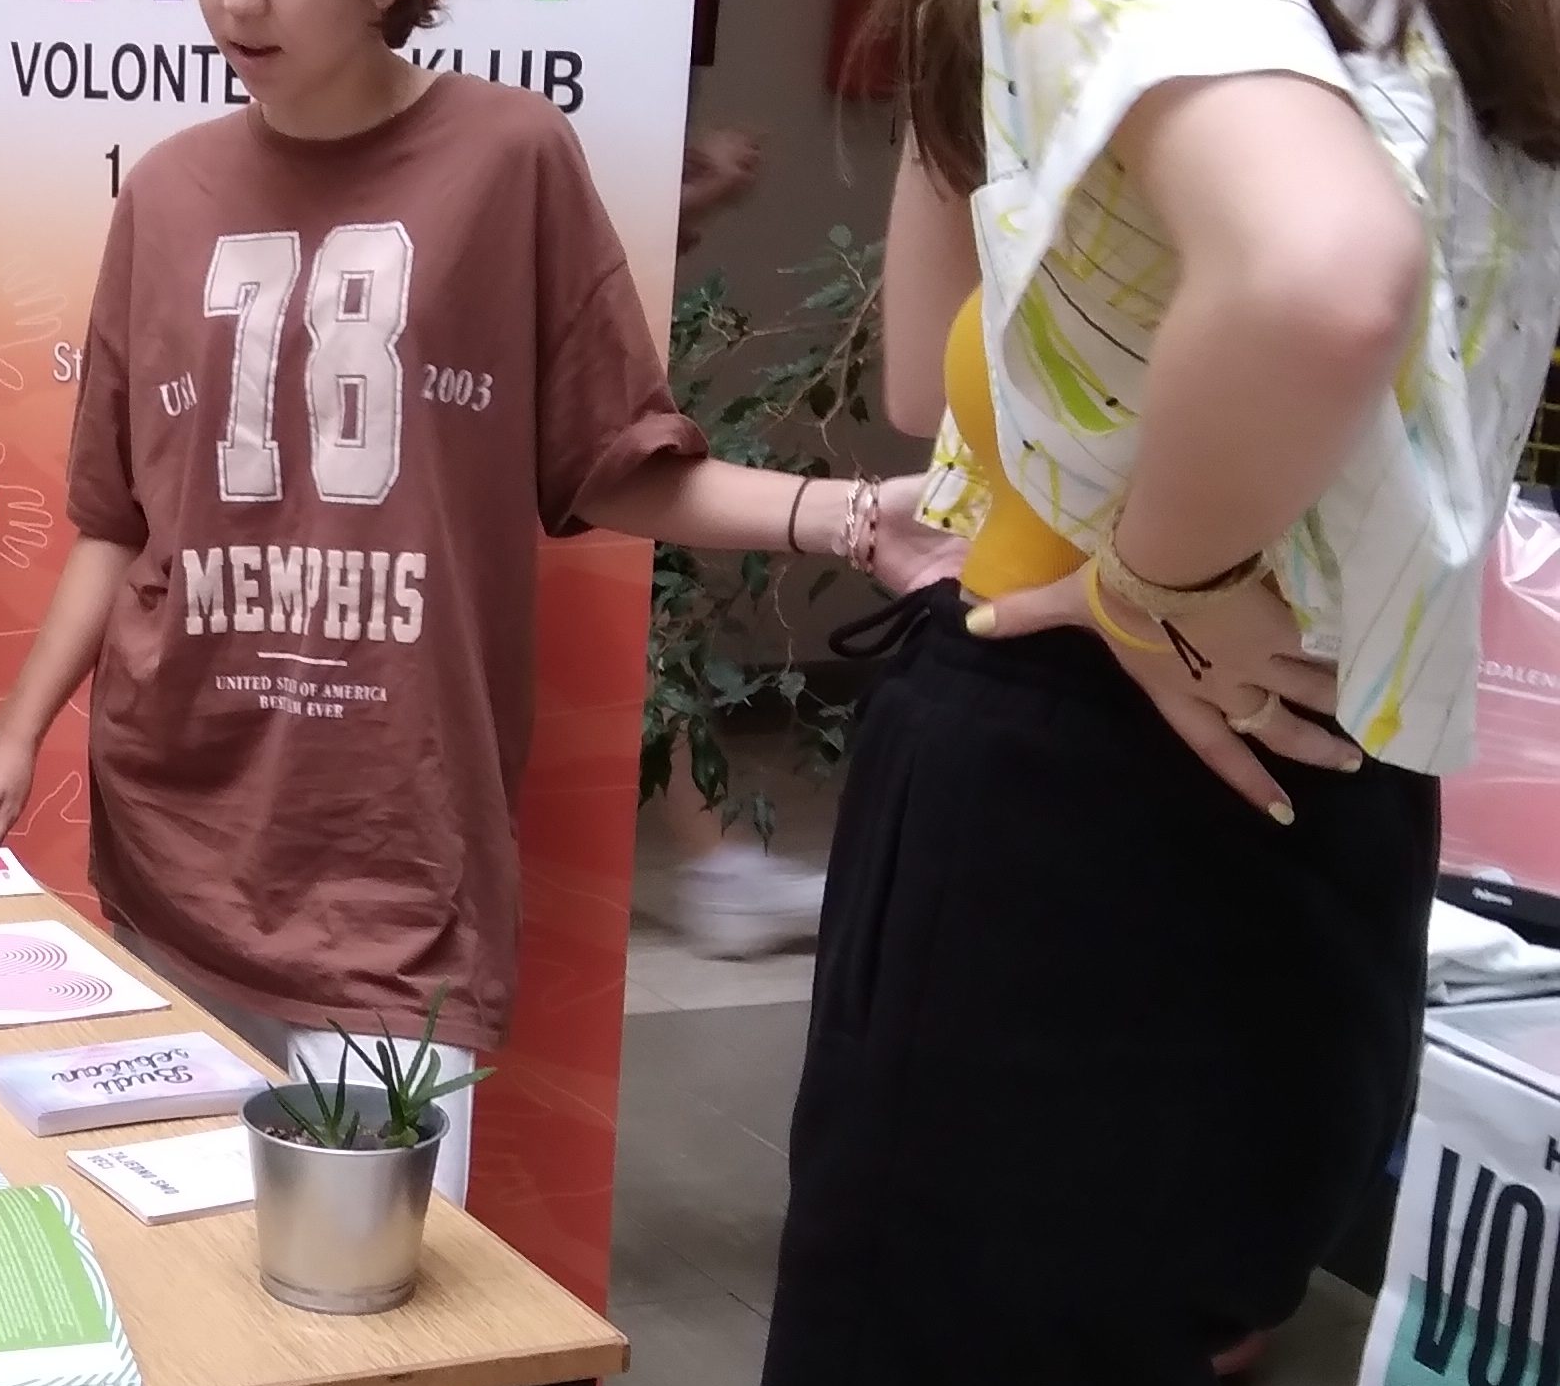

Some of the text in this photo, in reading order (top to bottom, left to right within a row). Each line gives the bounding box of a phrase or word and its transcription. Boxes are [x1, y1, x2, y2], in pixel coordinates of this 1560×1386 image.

[10, 40, 251, 105] VOLONTE
[52, 341, 84, 382] St
[202, 219, 414, 507] 78
[420, 362, 494, 413] 2003
[180, 544, 427, 645] MEMPHIS
[215, 675, 272, 691] UNITED
[299, 682, 318, 697] OF
[322, 684, 388, 702] AMERICA
[306, 702, 344, 719] EVER
[93, 1064, 193, 1096] Budi
